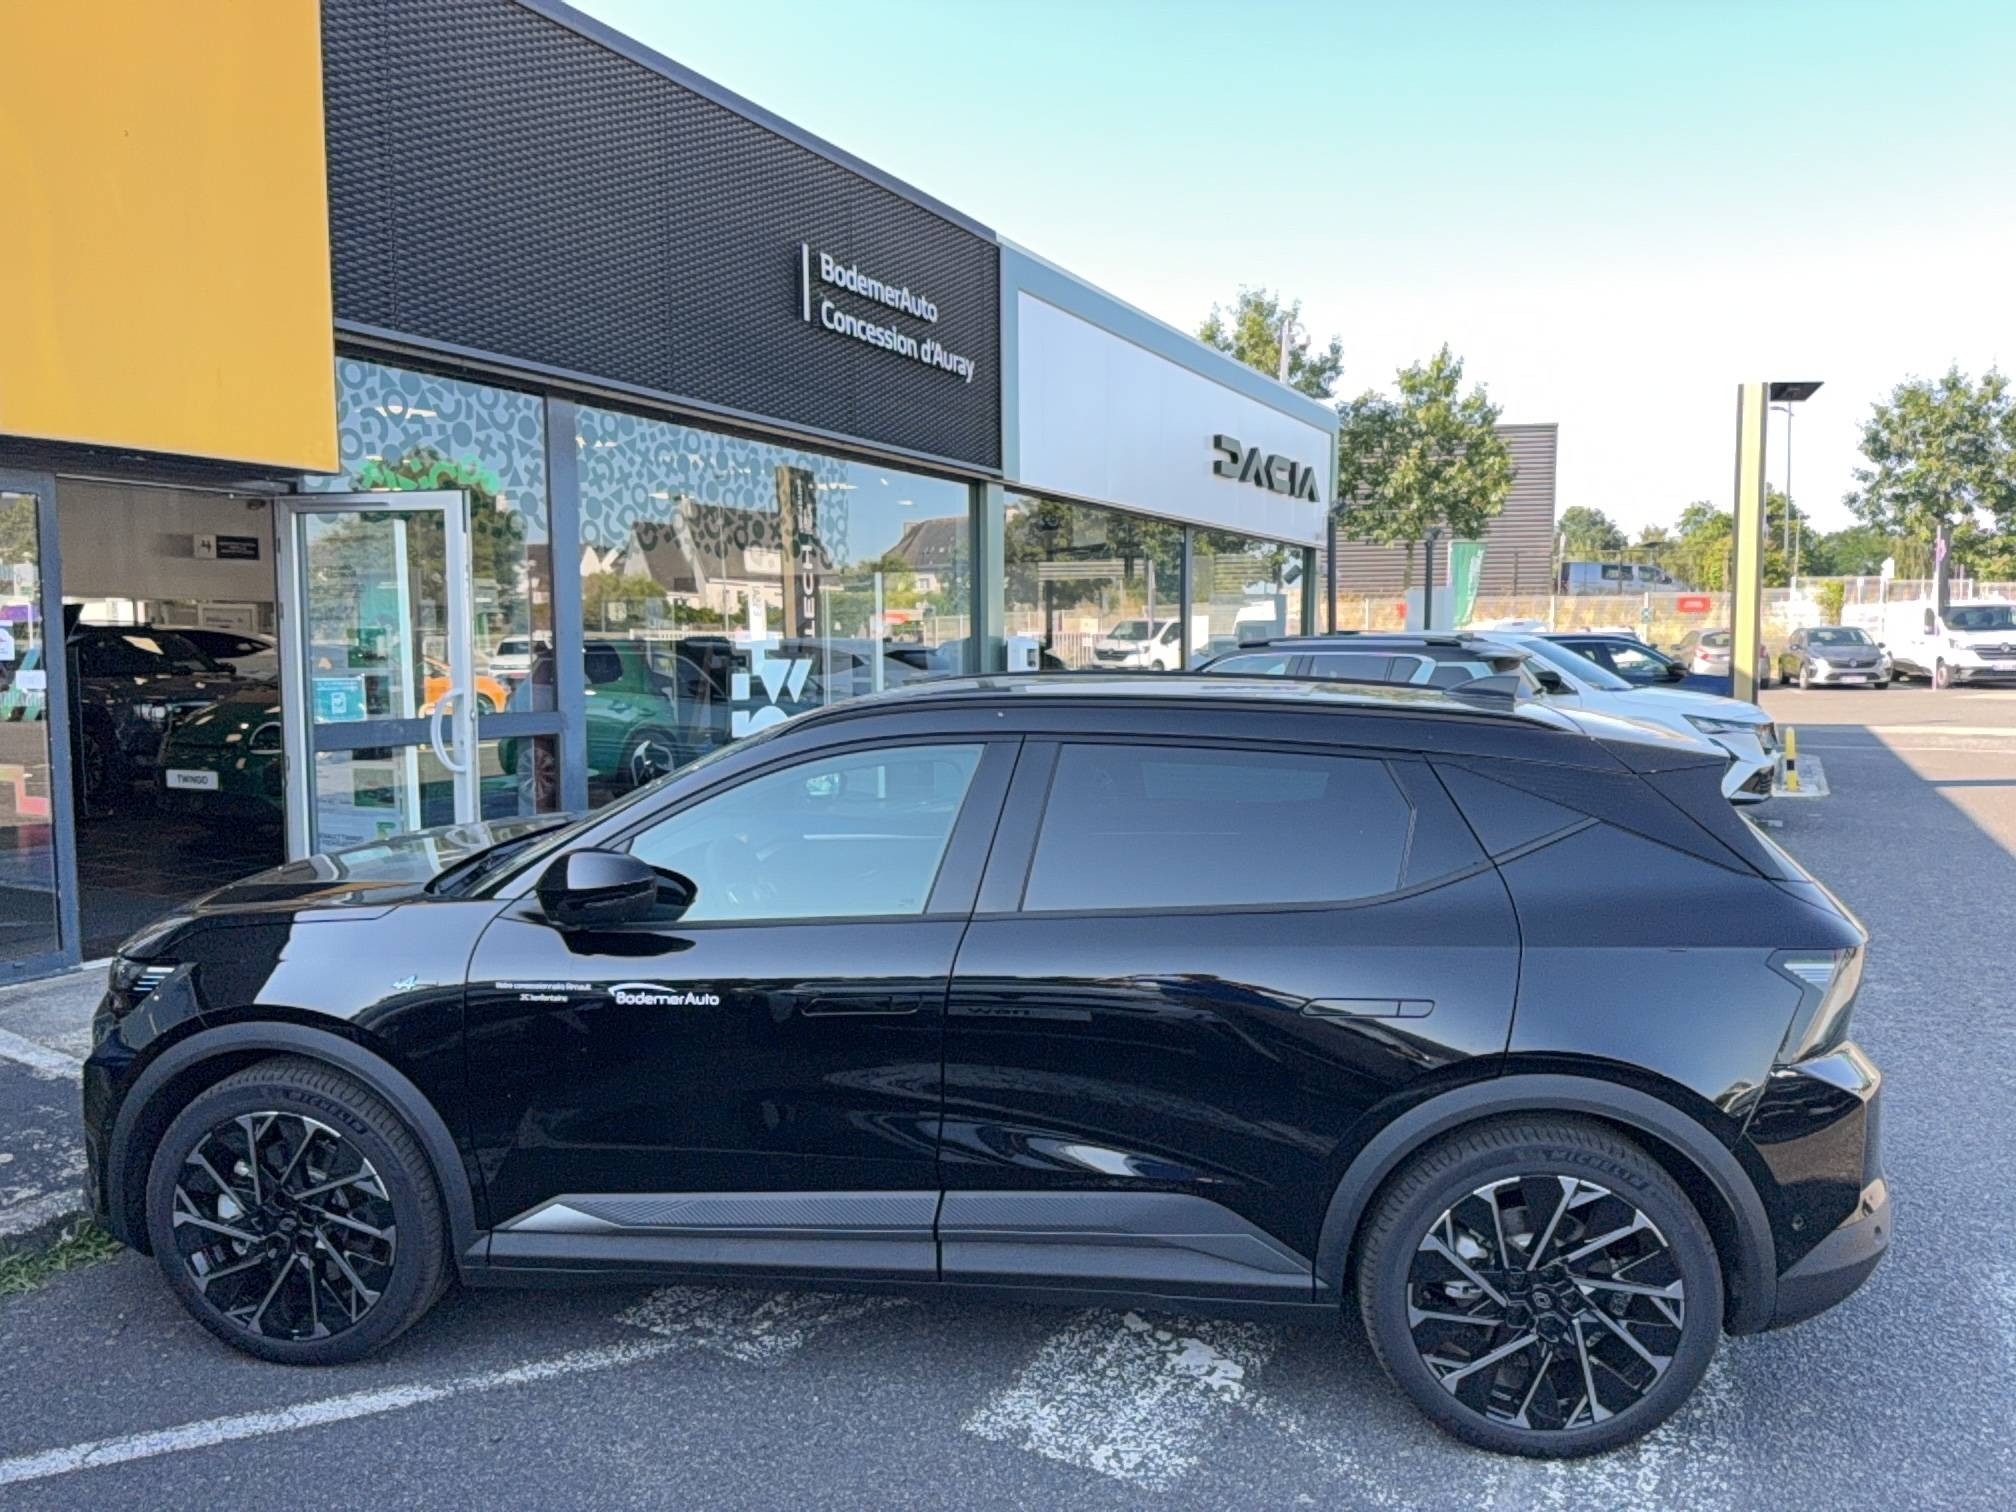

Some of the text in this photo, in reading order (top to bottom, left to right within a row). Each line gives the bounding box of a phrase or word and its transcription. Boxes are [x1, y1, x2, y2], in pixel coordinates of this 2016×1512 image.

[820, 252, 939, 324] BodemerAuto
[821, 300, 976, 384] Concession d'Auray
[1213, 433, 1320, 503] DACIA
